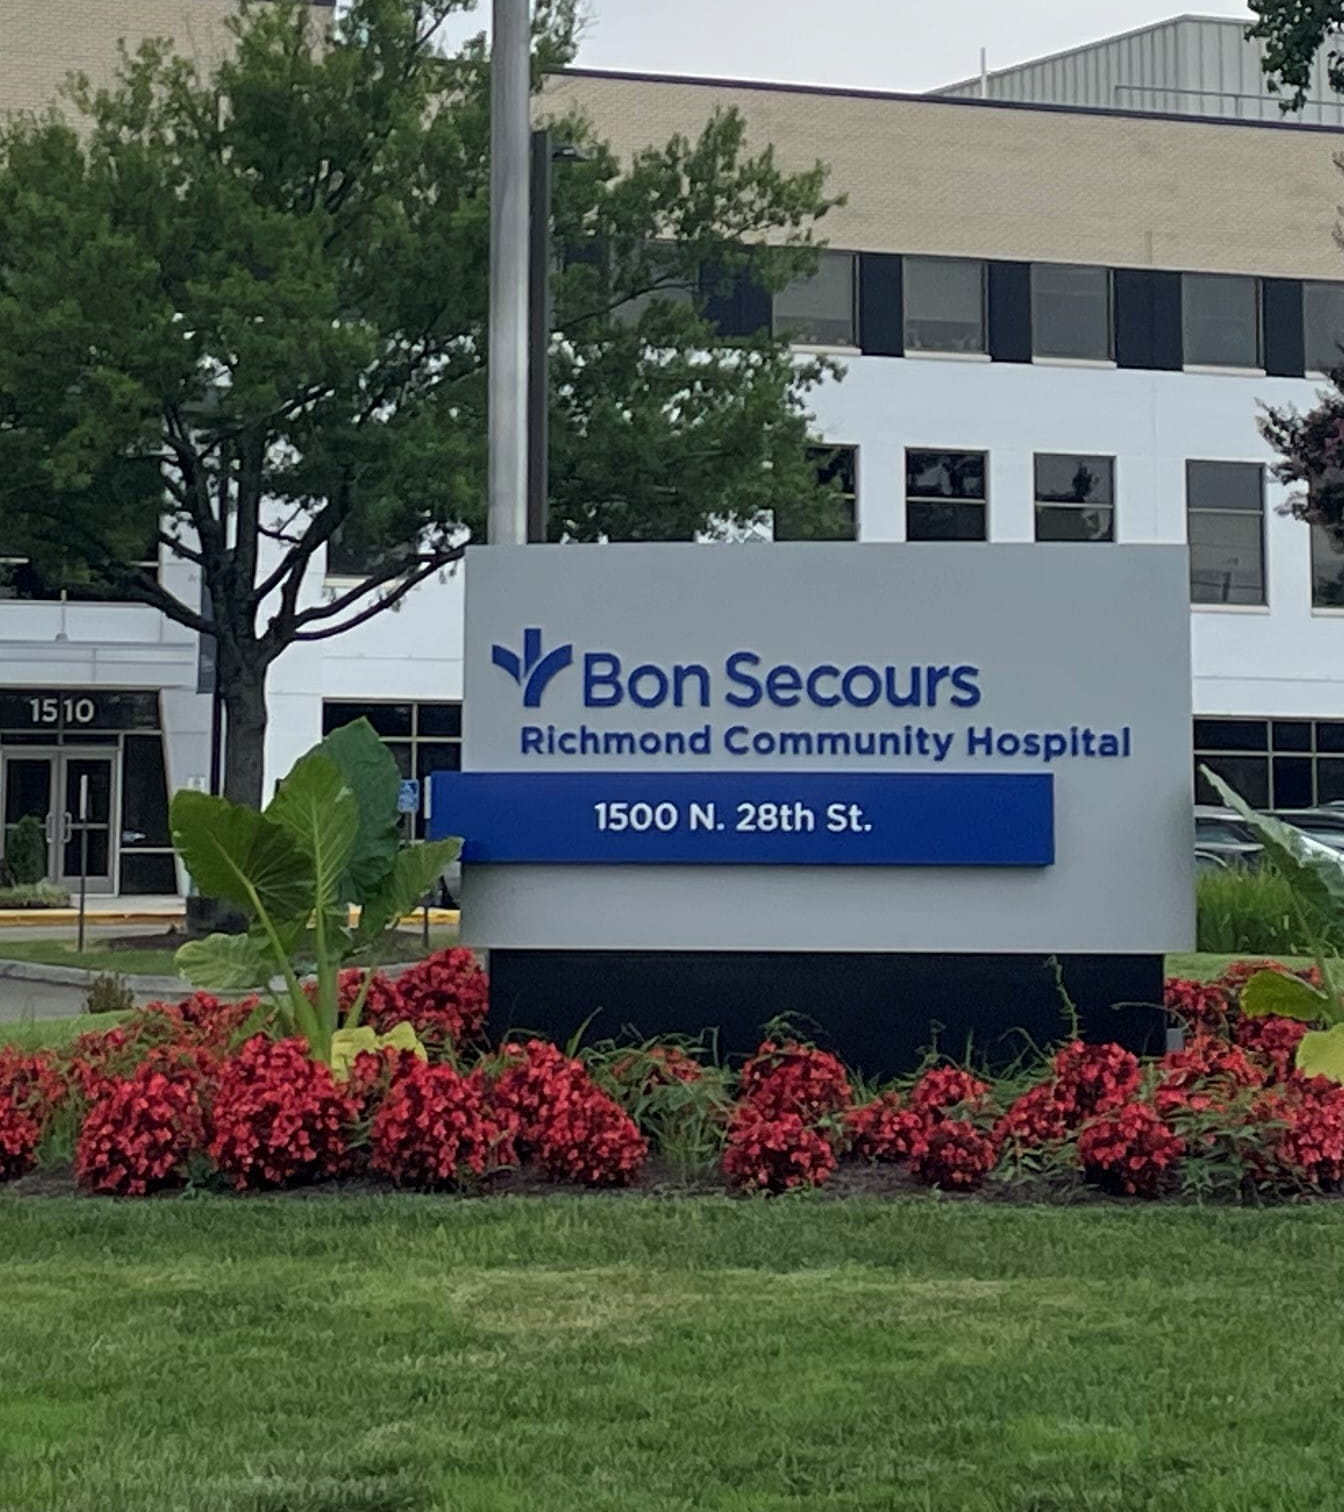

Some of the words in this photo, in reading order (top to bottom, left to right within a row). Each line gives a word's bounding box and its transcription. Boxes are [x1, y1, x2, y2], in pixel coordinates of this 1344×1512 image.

[582, 651, 711, 708] Bon
[725, 651, 982, 709] Secours
[30, 698, 95, 723] 1510
[519, 724, 713, 756] Richmond
[722, 724, 954, 762] Community
[964, 726, 1131, 763] Hospital
[594, 802, 678, 831] 1500
[690, 802, 725, 831] N.
[736, 802, 814, 831] 28th
[827, 803, 873, 832] St.
